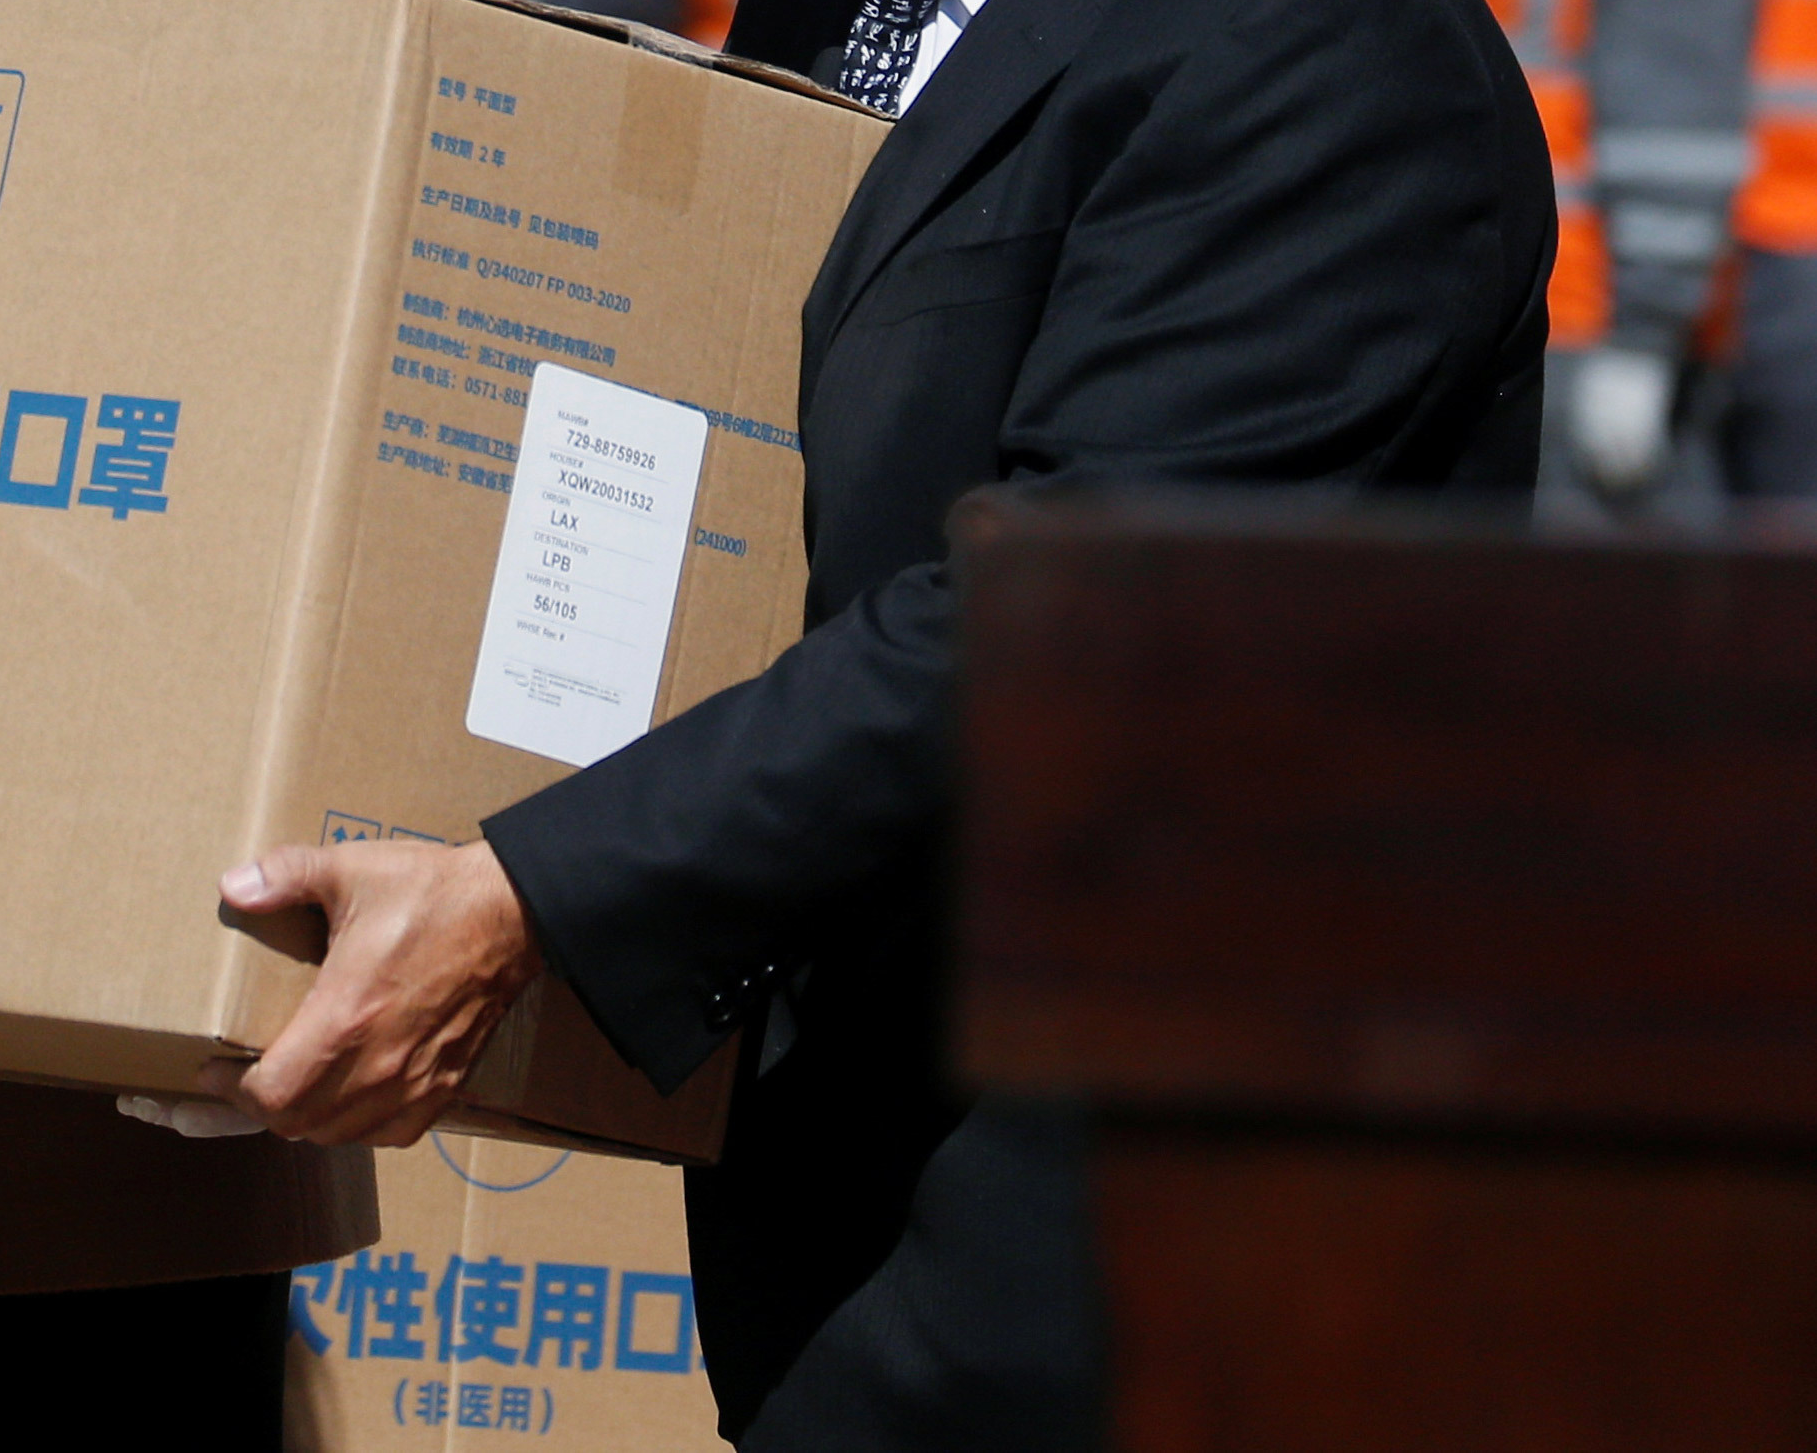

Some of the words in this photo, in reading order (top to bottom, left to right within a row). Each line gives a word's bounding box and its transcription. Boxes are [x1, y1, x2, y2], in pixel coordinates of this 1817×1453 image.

[438, 77, 466, 101] 型号
[431, 131, 474, 160] 有效期
[478, 146, 488, 163] 2
[492, 148, 506, 168] 年
[421, 185, 521, 229] 生产日期及批号
[528, 214, 599, 250] 见包装喷码
[412, 238, 470, 270] 执行标准
[477, 258, 544, 289] Q/340207
[546, 276, 565, 294] FP
[567, 282, 631, 313] 003-2020
[457, 306, 616, 367] 杭州心选电子商务有限公司
[550, 452, 584, 468] HOUSE#
[567, 429, 656, 470] 729-88759926
[542, 491, 571, 506] ORIGIN
[558, 469, 654, 512] XQW20031532
[550, 509, 580, 531] LAX
[534, 531, 589, 556] DESTINATION
[695, 527, 747, 557] (241000)
[542, 550, 571, 572] LPB
[534, 594, 578, 621] 56/105
[393, 1379, 554, 1434] (非医用)
